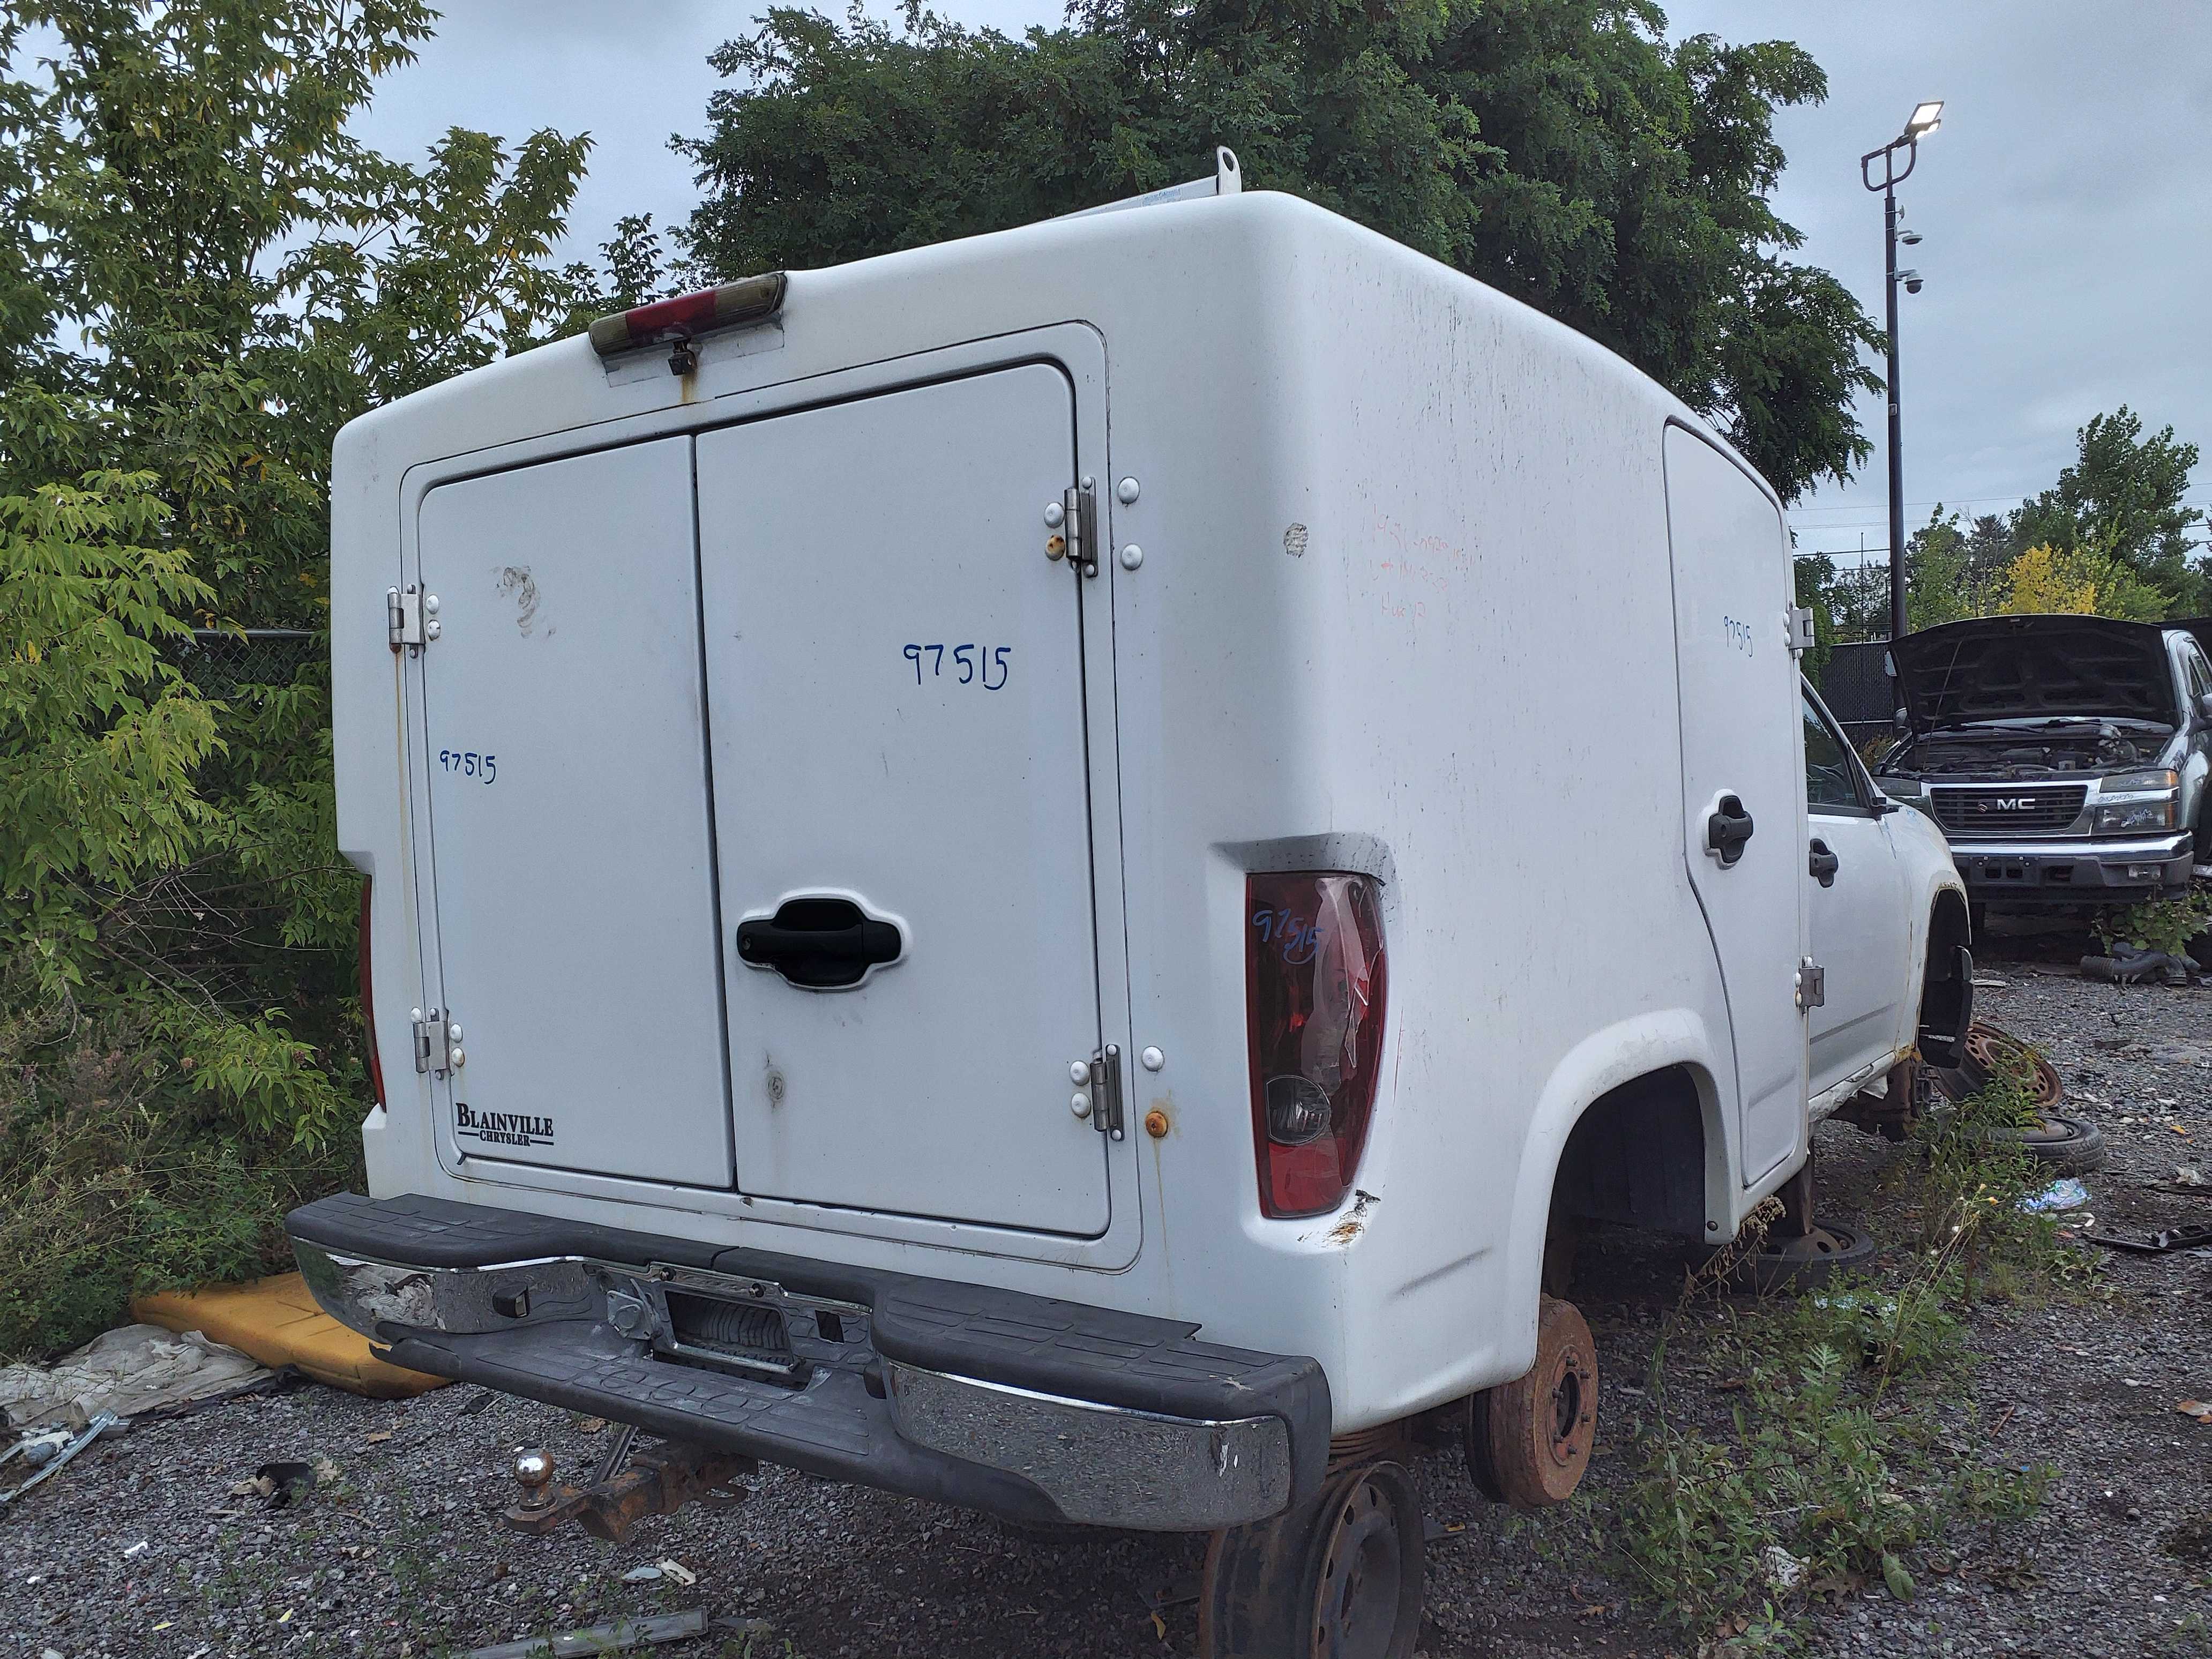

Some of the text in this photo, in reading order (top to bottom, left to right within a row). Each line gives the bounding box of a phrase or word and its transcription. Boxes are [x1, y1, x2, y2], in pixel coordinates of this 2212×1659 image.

[1724, 615, 1753, 657] 97515
[903, 644, 1011, 690] 97515
[440, 750, 496, 784] 97515
[1252, 908, 1324, 965] 97515
[455, 1102, 554, 1137] BLAINVILLE
[480, 1130, 530, 1147] CHRYSLER
